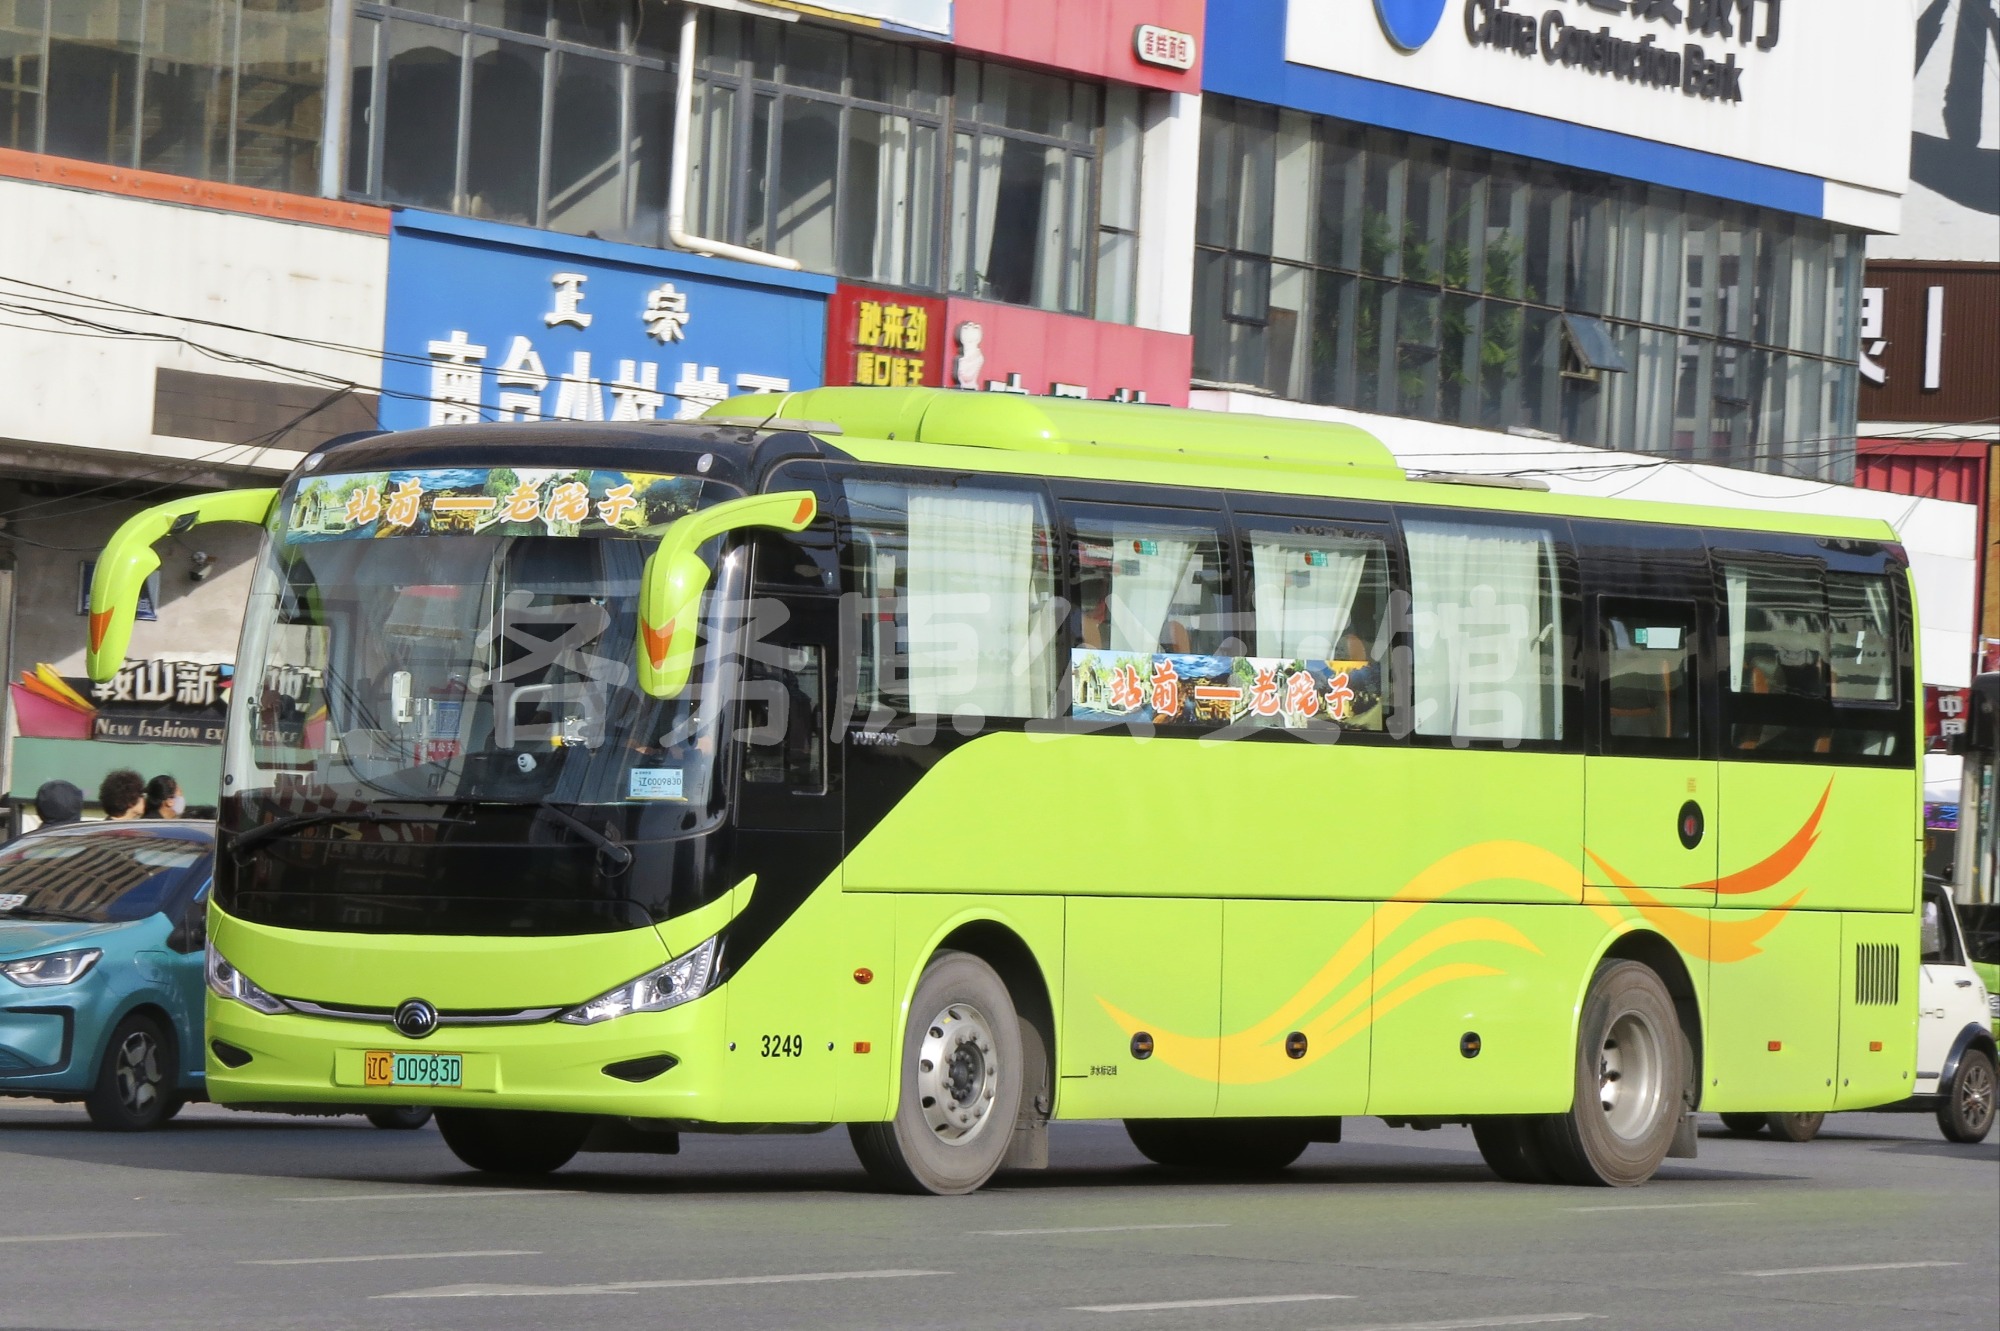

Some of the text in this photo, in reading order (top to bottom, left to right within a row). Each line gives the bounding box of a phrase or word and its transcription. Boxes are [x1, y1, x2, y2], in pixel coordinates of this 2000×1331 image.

[1464, 0, 1537, 59] China
[1541, 10, 1681, 91] Construction
[1683, 43, 1743, 105] Bank
[544, 273, 691, 347] 正宗
[397, 1058, 460, 1082] 00983D
[761, 1034, 803, 1058] 3249
